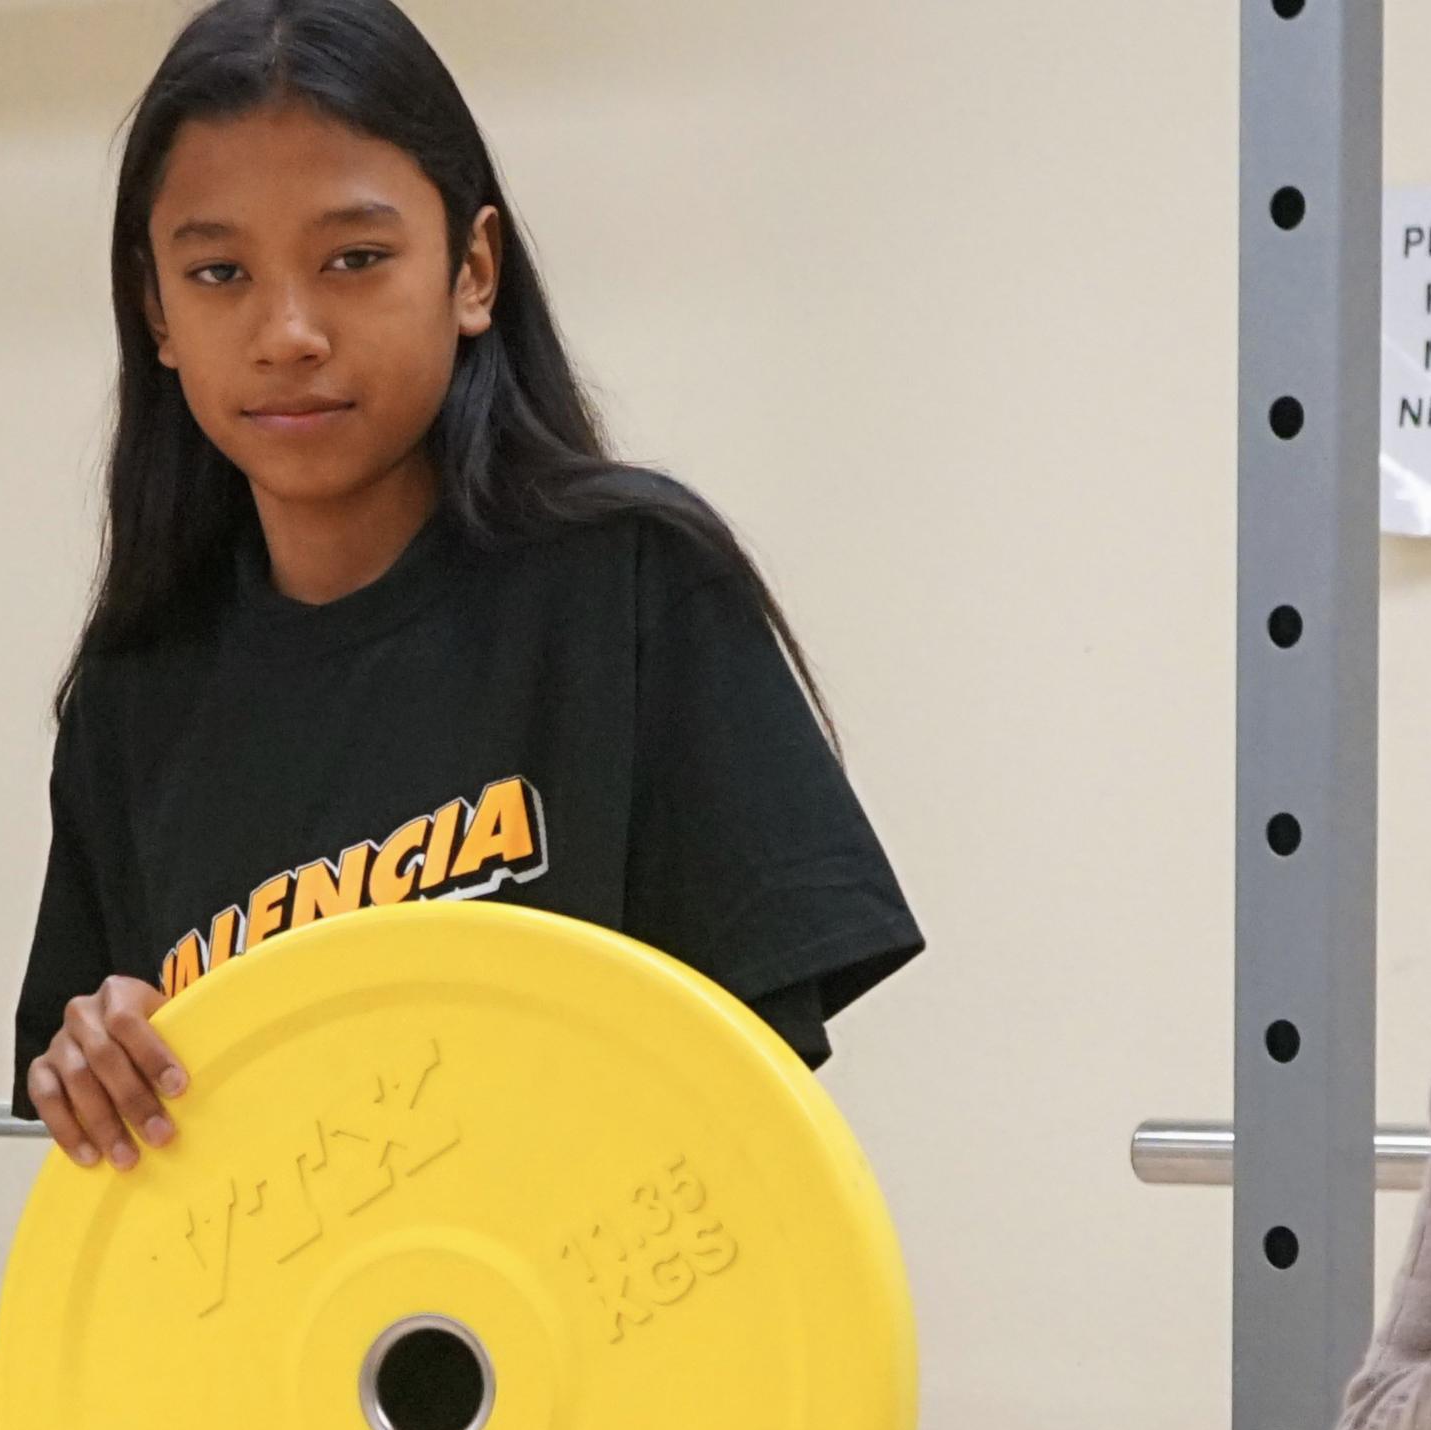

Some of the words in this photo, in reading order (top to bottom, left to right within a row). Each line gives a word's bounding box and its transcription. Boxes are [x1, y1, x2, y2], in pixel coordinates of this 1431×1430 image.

[151, 1036, 462, 1319] VTX
[561, 1154, 709, 1284] 11.35
[599, 1220, 739, 1346] KGS
